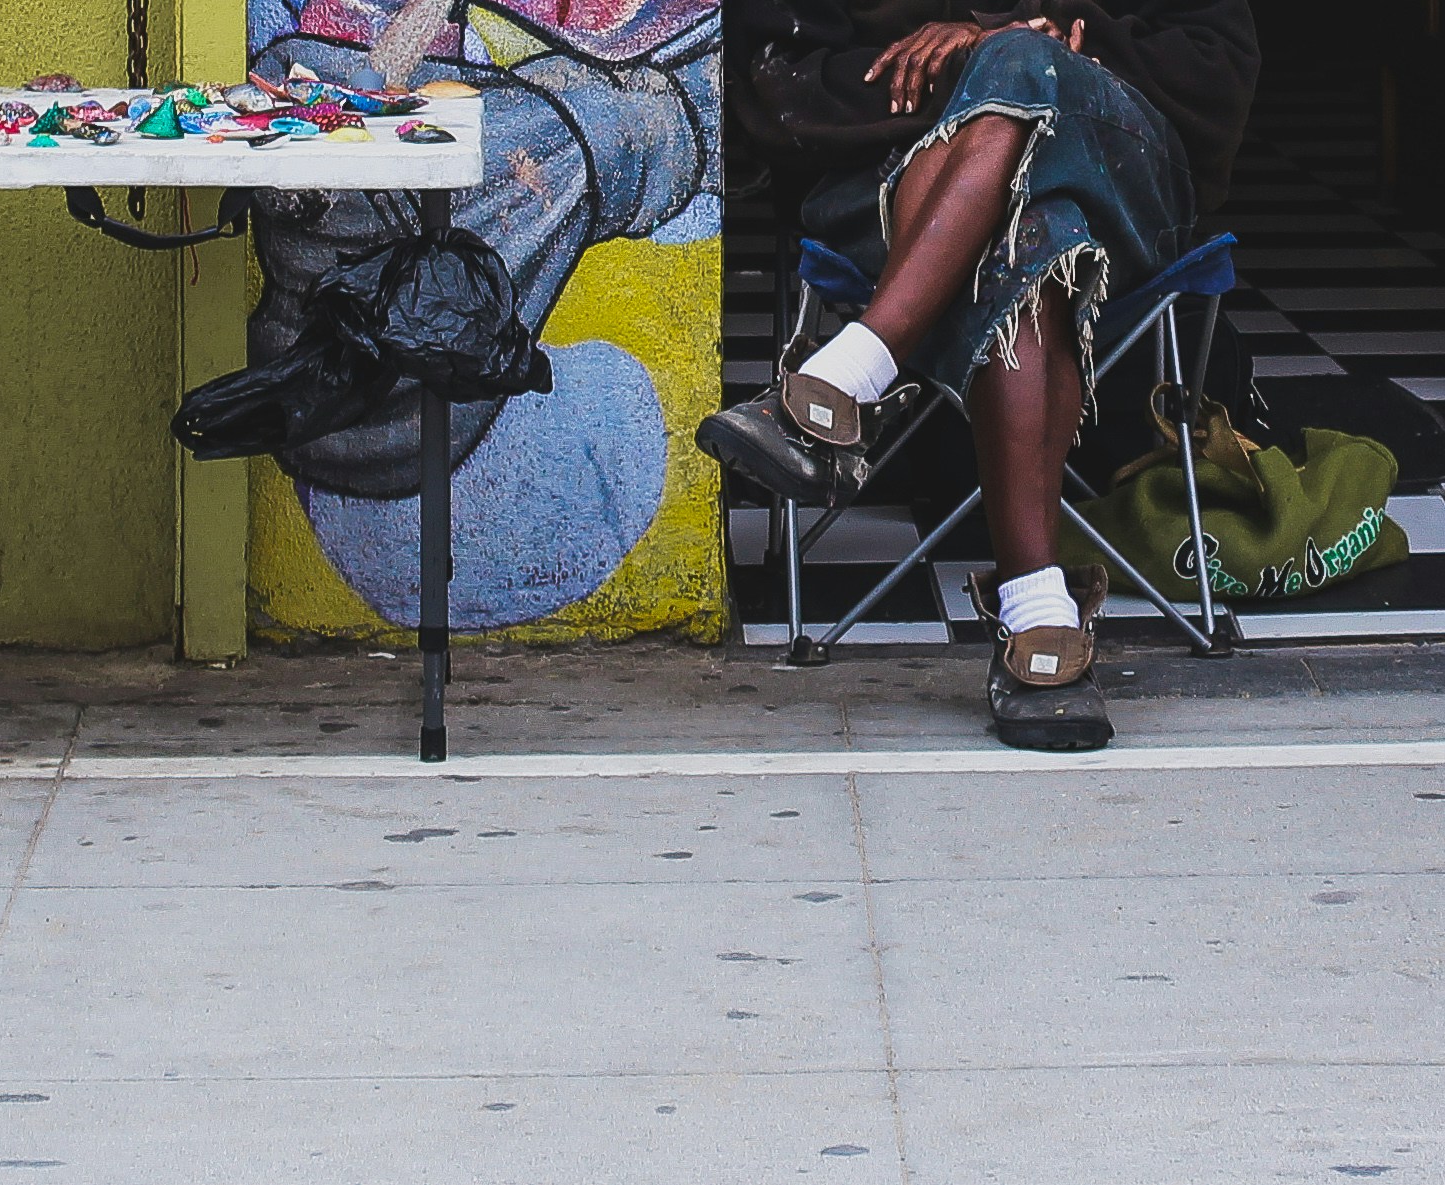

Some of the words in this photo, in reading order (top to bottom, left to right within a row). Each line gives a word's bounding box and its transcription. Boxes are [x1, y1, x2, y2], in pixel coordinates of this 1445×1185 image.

[1173, 531, 1248, 596] Give
[1254, 557, 1303, 598] Me
[1305, 506, 1384, 588] Organi
